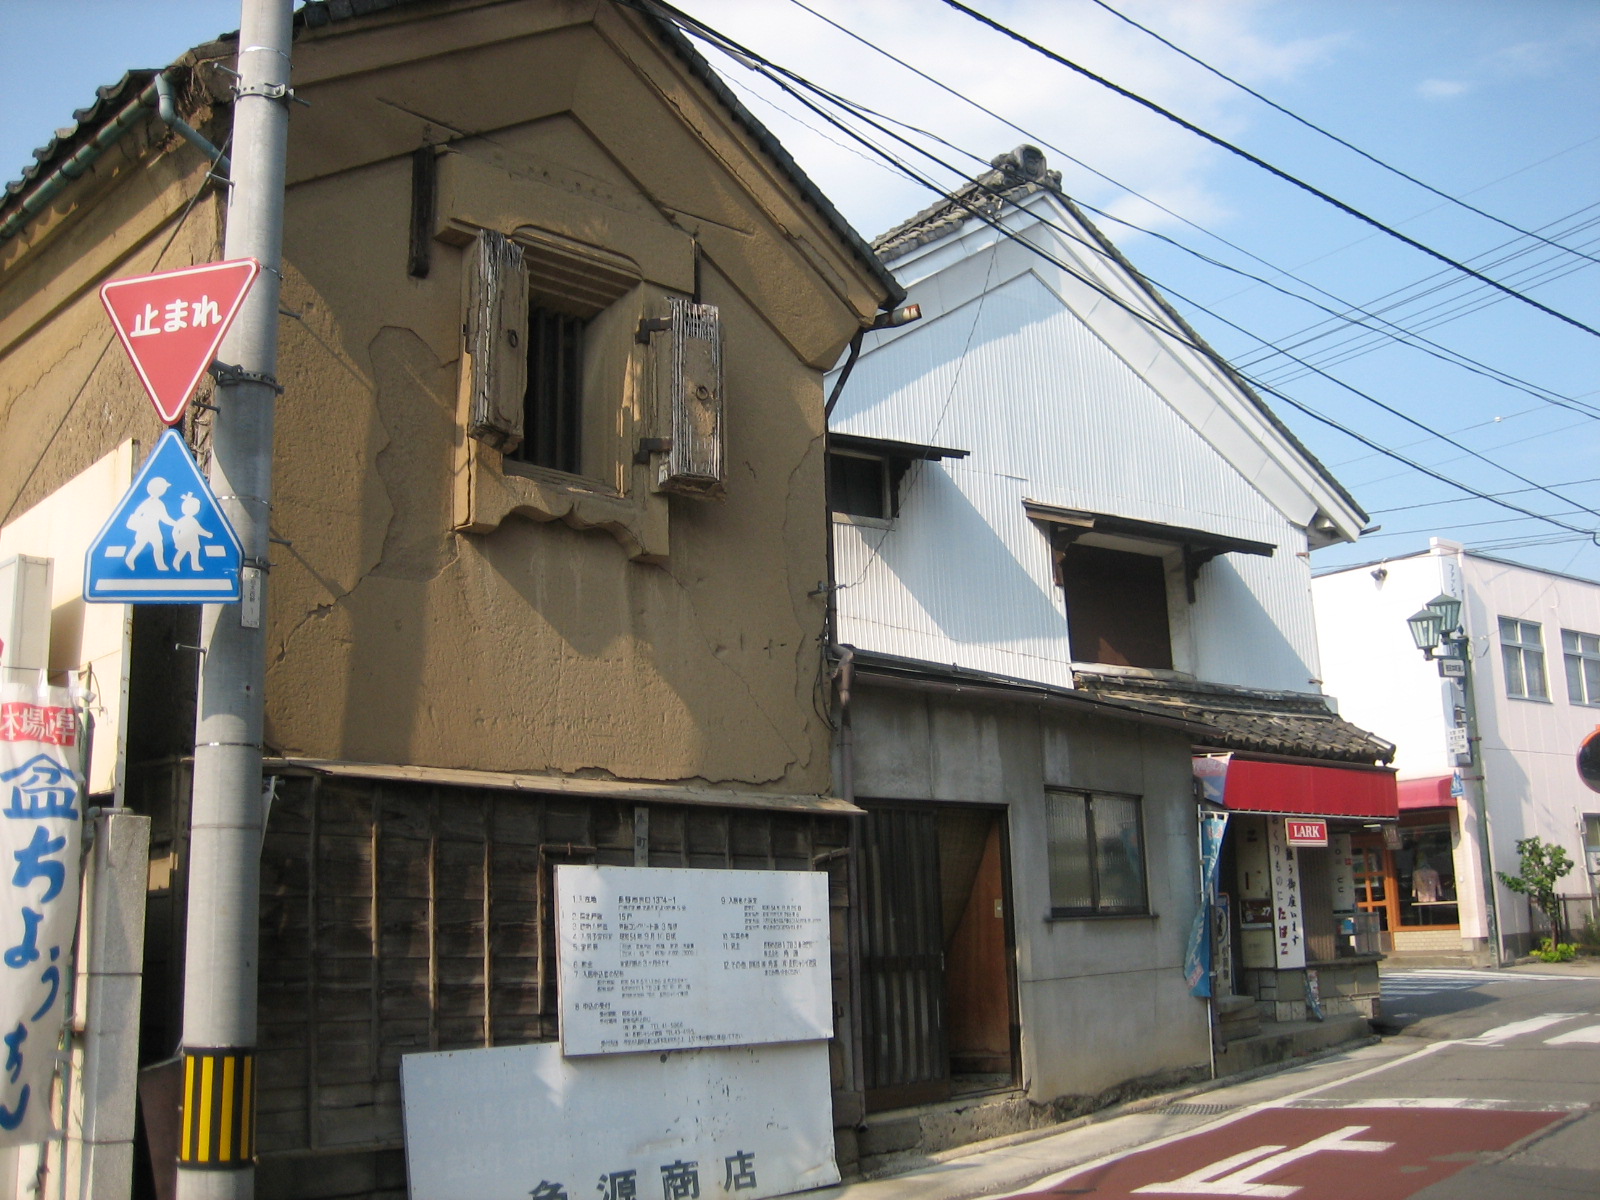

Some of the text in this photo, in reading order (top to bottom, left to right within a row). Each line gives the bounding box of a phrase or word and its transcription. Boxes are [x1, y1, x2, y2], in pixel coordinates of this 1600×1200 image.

[130, 295, 223, 338] 止まれ
[1293, 825, 1320, 838] LARK
